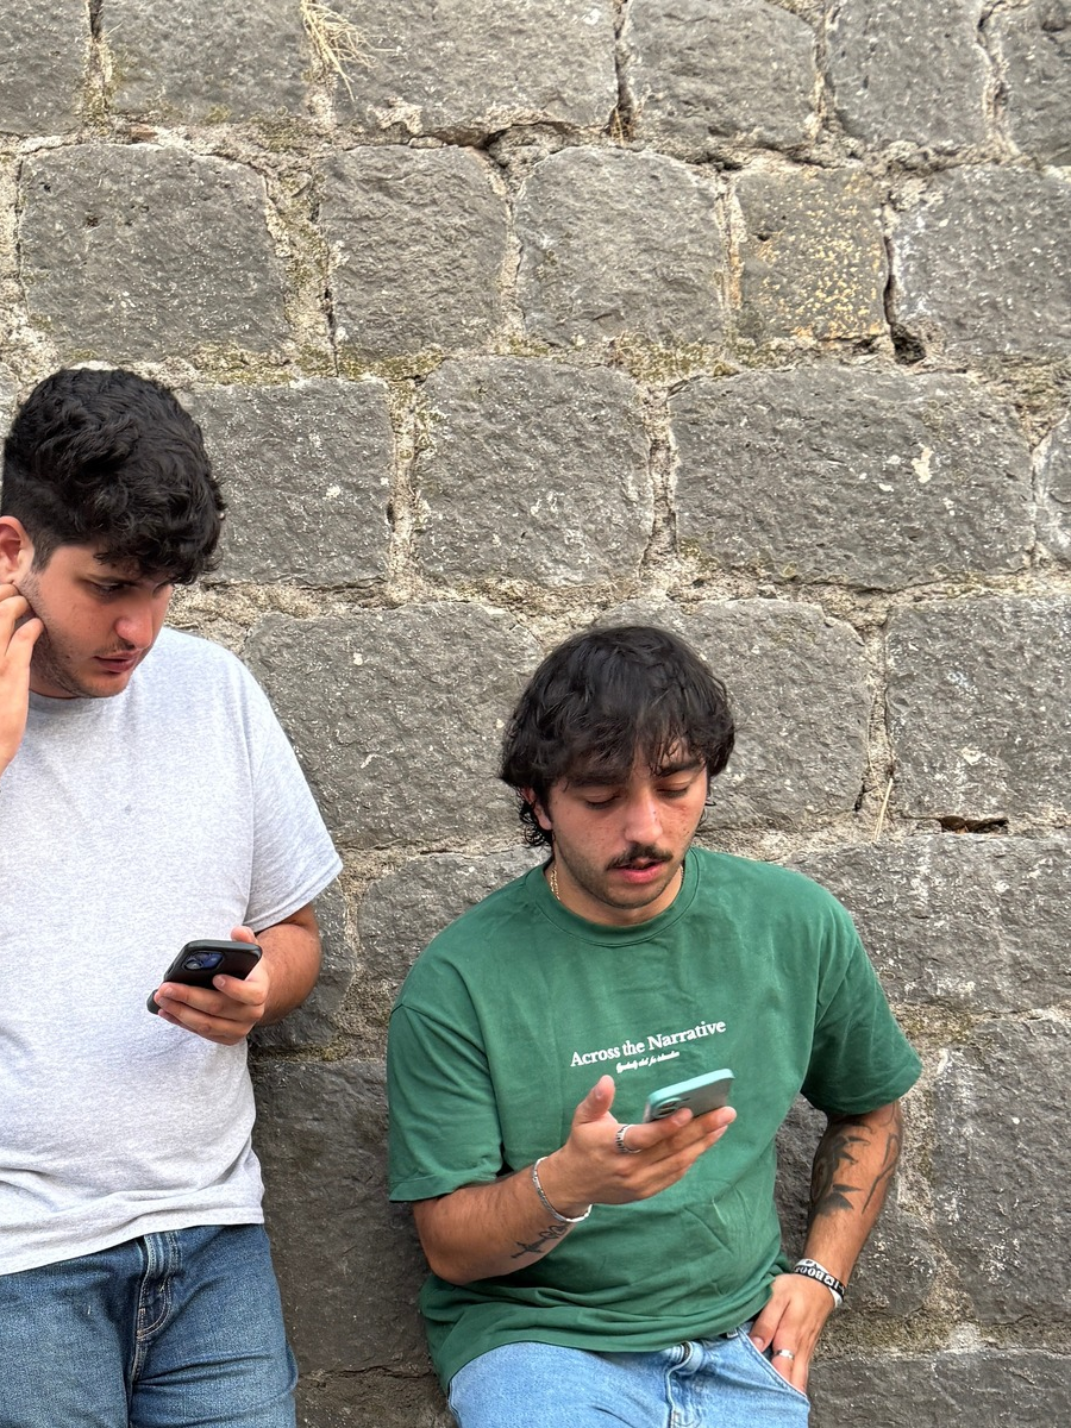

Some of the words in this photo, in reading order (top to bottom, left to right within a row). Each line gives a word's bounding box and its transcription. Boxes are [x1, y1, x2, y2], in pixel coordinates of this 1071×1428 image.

[570, 1046, 621, 1067] Across
[622, 1040, 646, 1056] the
[647, 1021, 727, 1051] Narrative
